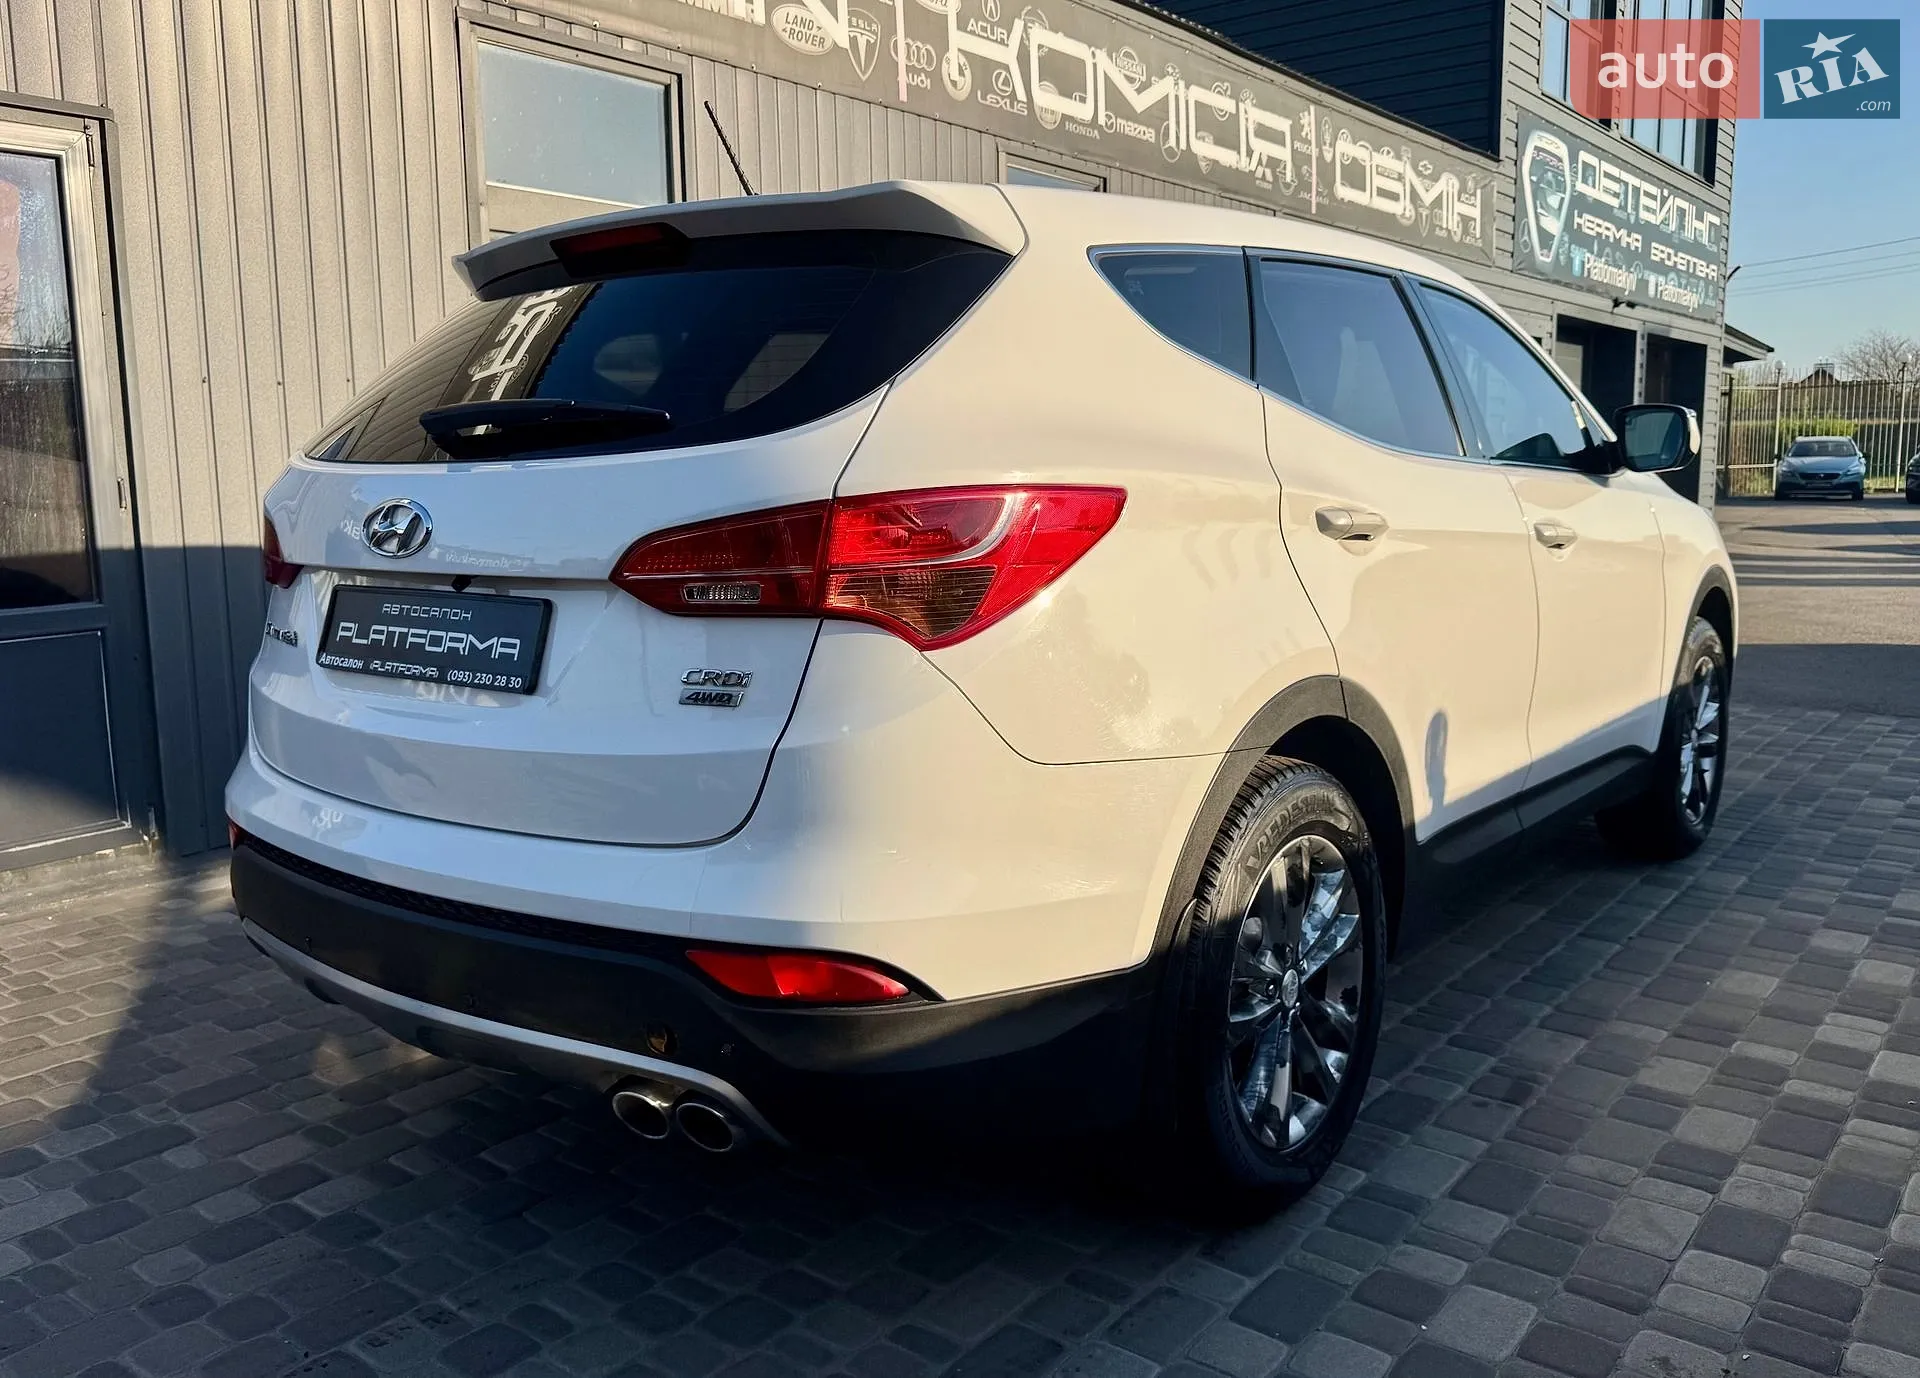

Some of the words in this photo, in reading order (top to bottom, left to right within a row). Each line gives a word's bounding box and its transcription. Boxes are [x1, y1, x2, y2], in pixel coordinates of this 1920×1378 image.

[784, 12, 815, 33] LAND
[849, 15, 878, 33] ESLA
[787, 27, 827, 49] ROVER
[977, 90, 1028, 116] LEXUS
[1064, 120, 1100, 140] HONDA
[382, 603, 472, 621] АВТОСАЛОН
[336, 621, 520, 661] PLATFORMA
[319, 652, 364, 670] Автосалон
[447, 670, 473, 685] (093)
[474, 673, 492, 686] 230
[494, 675, 507, 687] 28
[508, 676, 522, 689] 30
[681, 668, 753, 688] CRDi
